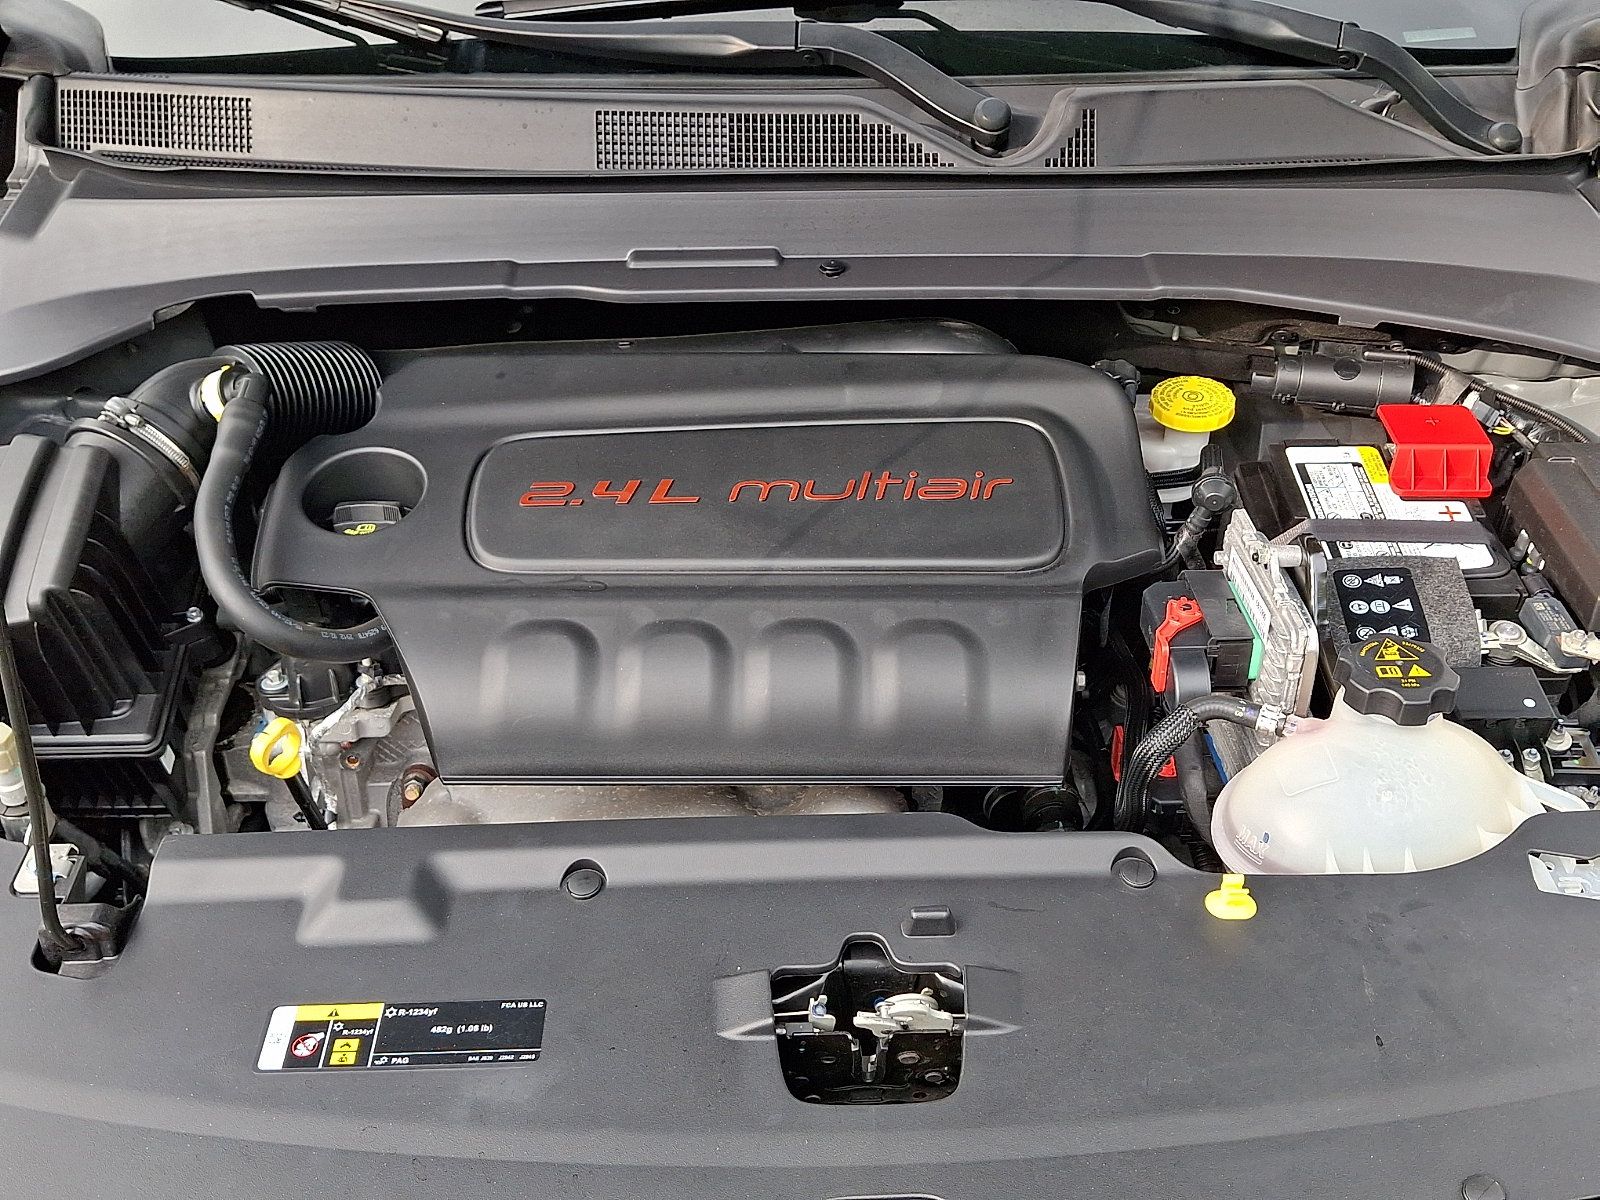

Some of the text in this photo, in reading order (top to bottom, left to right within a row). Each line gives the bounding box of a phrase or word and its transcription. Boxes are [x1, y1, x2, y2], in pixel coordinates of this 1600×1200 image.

[728, 470, 1014, 502] multiair
[1235, 823, 1270, 860] MAX
[501, 1001, 517, 1009] FCA
[398, 1007, 439, 1017] R-1234yf
[391, 1056, 410, 1065] PAG
